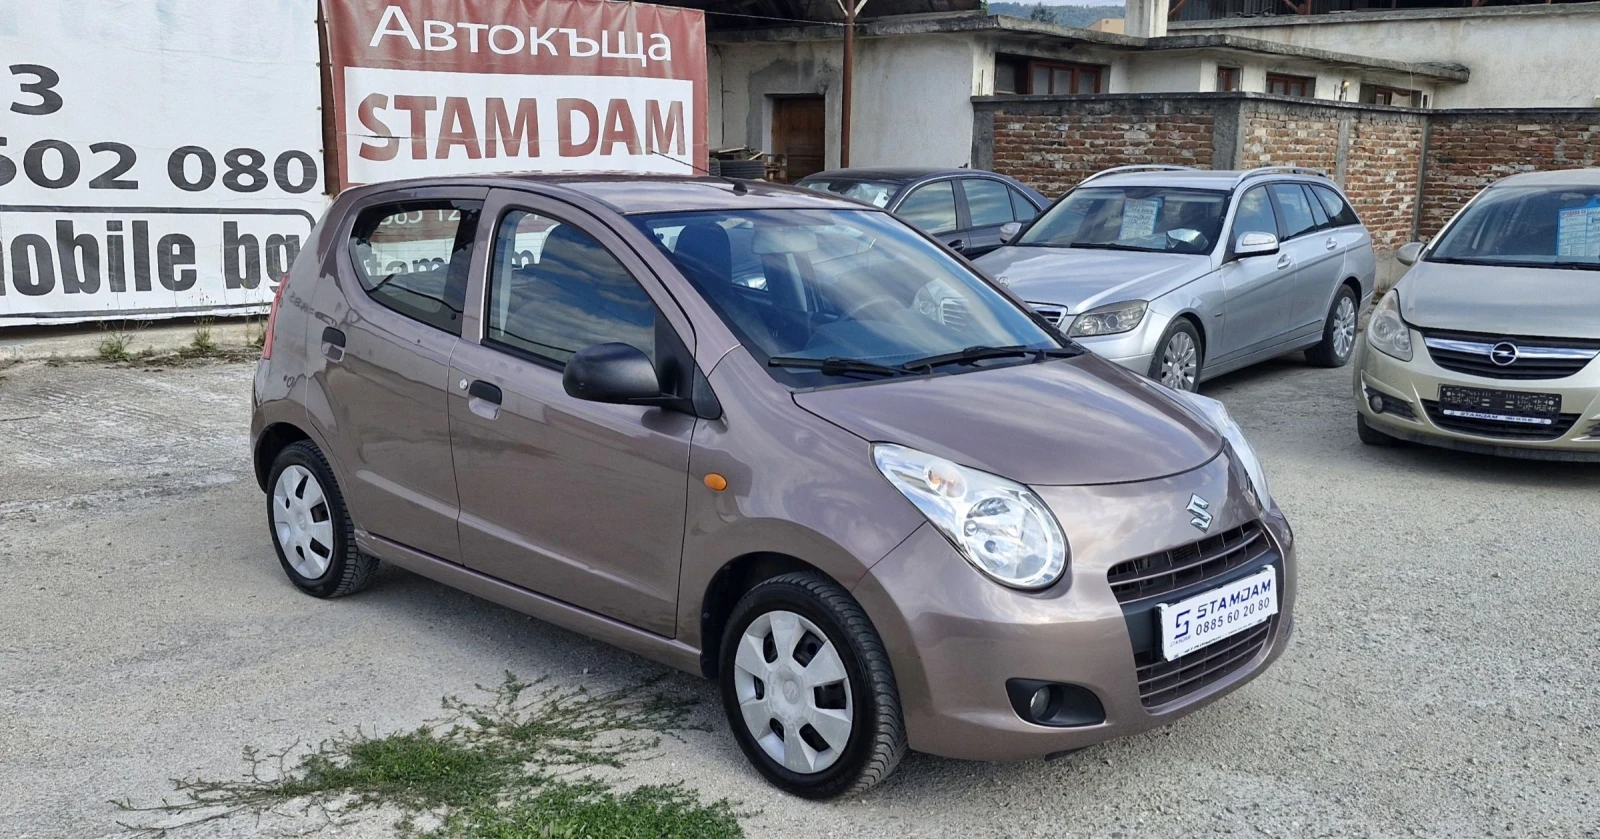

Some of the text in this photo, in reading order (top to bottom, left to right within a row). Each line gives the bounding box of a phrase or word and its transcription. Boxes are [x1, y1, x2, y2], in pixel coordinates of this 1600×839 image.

[369, 5, 672, 68] Автокъща
[9, 64, 63, 115] 3
[358, 93, 686, 162] STAM DAM
[168, 145, 317, 194] 080
[0, 220, 197, 296] obile
[1196, 615, 1224, 635] 0885
[1227, 609, 1240, 624] 60
[1243, 603, 1255, 617] 20
[1258, 597, 1271, 611] 80
